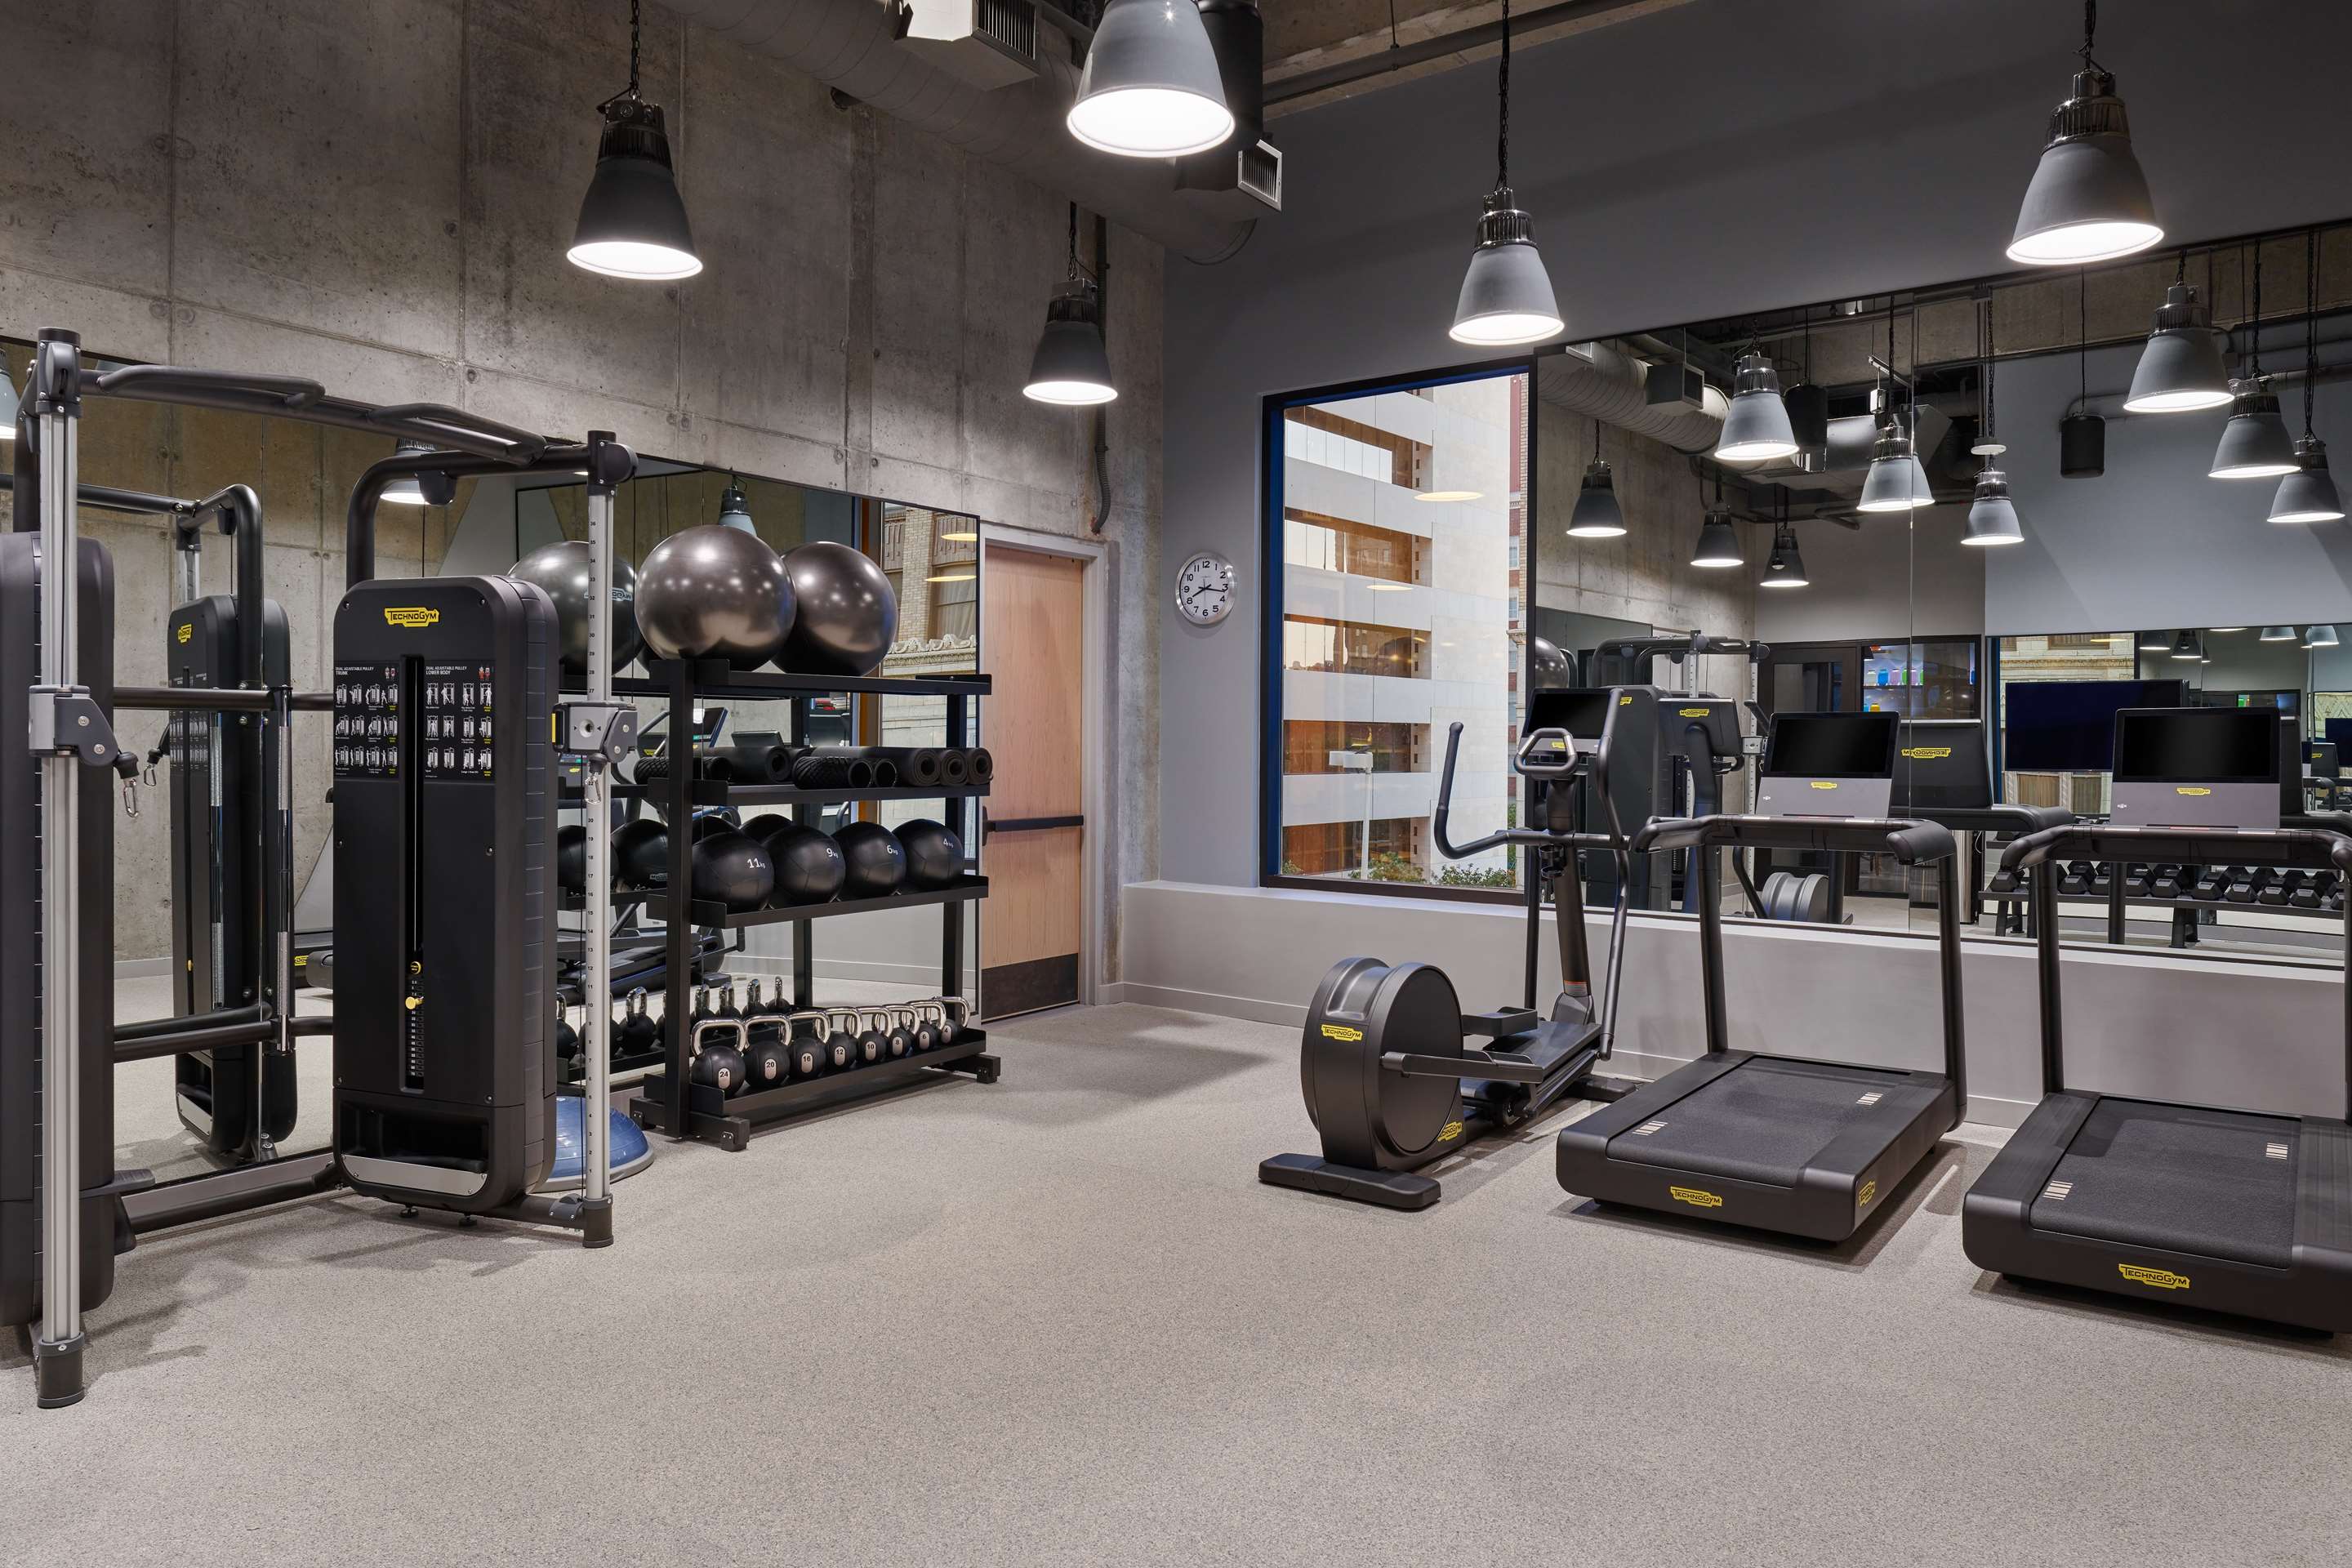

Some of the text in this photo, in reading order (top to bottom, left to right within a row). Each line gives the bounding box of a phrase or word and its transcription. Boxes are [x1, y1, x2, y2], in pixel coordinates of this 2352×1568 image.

[1194, 564, 1200, 572] 11
[1187, 573, 1193, 581] 10
[1220, 571, 1226, 579] 2
[1222, 583, 1228, 591] 3
[386, 609, 437, 624] TECHNOGYM
[1322, 1026, 1361, 1039] TECHNOGYM
[766, 1061, 775, 1069] 20
[1673, 1189, 1720, 1205] TECHNOGYM
[2120, 1266, 2187, 1285] TECHNOGYM
